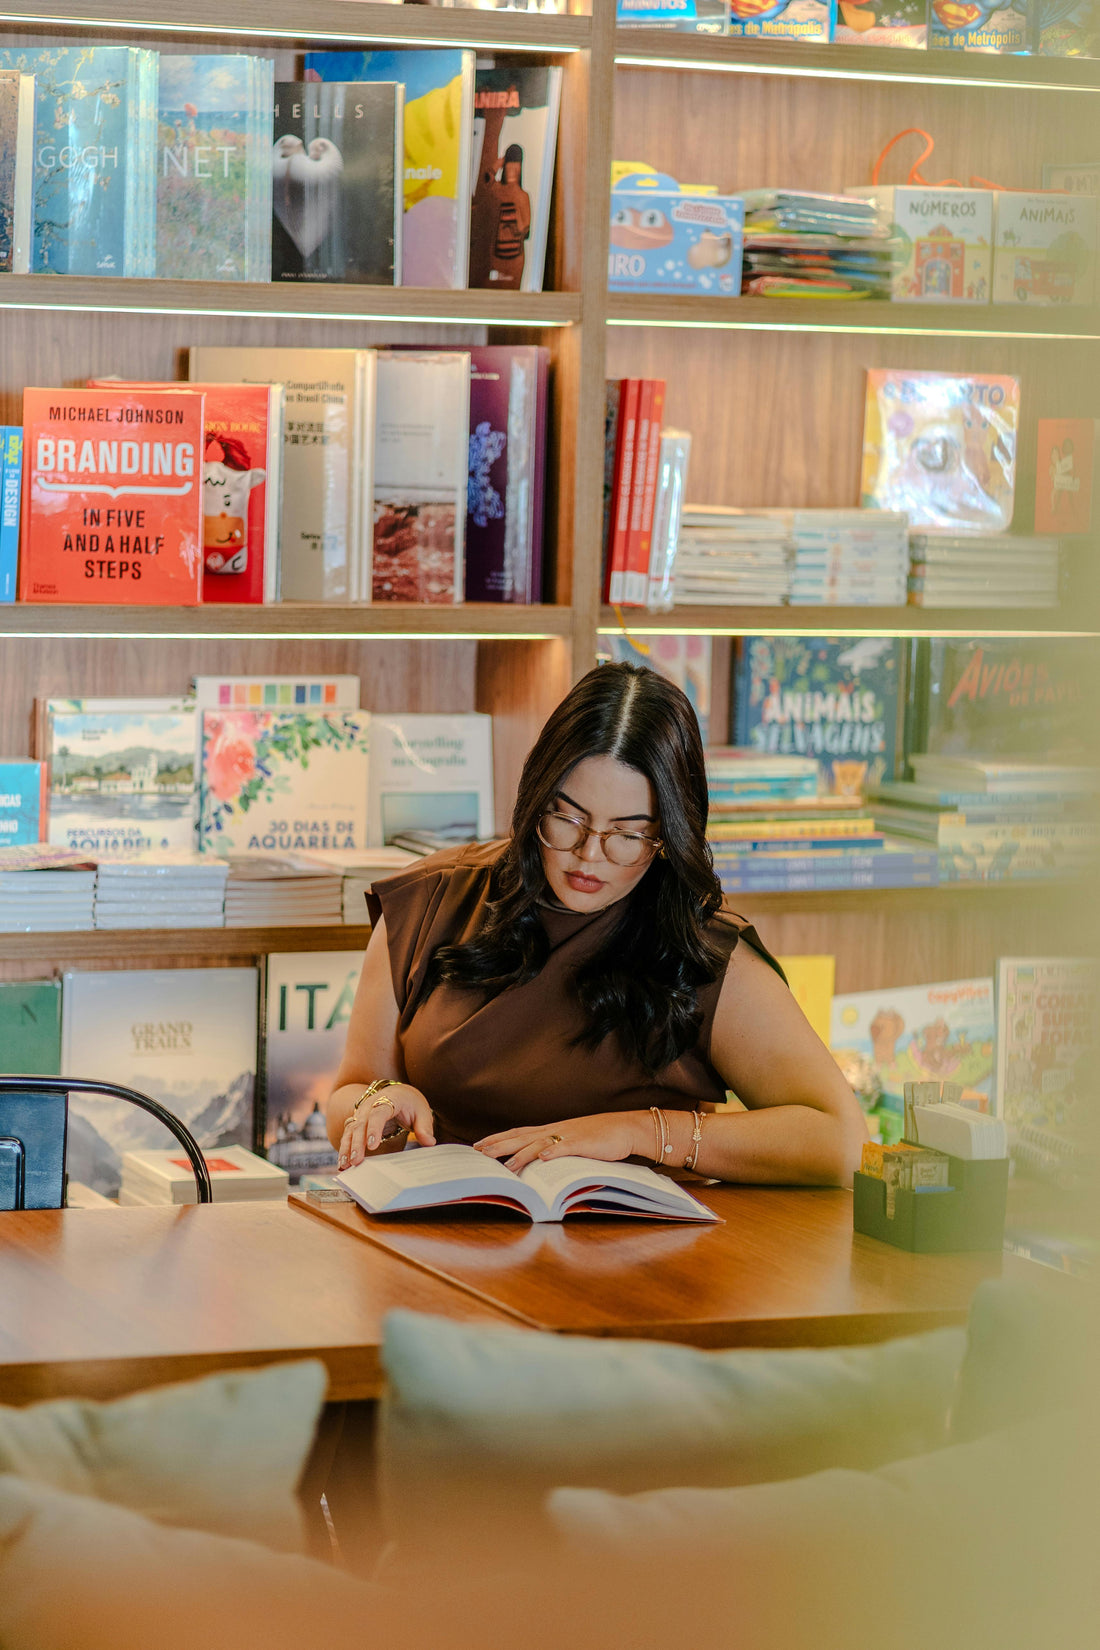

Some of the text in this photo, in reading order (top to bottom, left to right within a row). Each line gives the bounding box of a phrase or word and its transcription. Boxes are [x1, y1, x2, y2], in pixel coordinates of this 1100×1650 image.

[745, 21, 760, 35] de
[953, 32, 965, 47] de
[968, 31, 1021, 49] Metrópolis
[38, 146, 118, 169] GOGH
[163, 146, 237, 178] NET
[404, 164, 442, 180] nale
[909, 199, 977, 217] NÚMEROS
[1019, 206, 1076, 225] ANIMAIS
[49, 407, 185, 424] MICHAEL JOHNSON
[37, 439, 194, 476] BRANDING
[4, 479, 19, 527] DESIGN
[83, 509, 145, 528] IN FIVE
[63, 534, 165, 555] AND A HALF
[85, 560, 142, 580] STEPS
[762, 690, 876, 723] ANIMAIS
[270, 821, 354, 833] 30 DIAS DE
[248, 835, 355, 850] AQUARELA
[131, 1021, 193, 1037] GRAND
[134, 1035, 192, 1050] TRAILS
